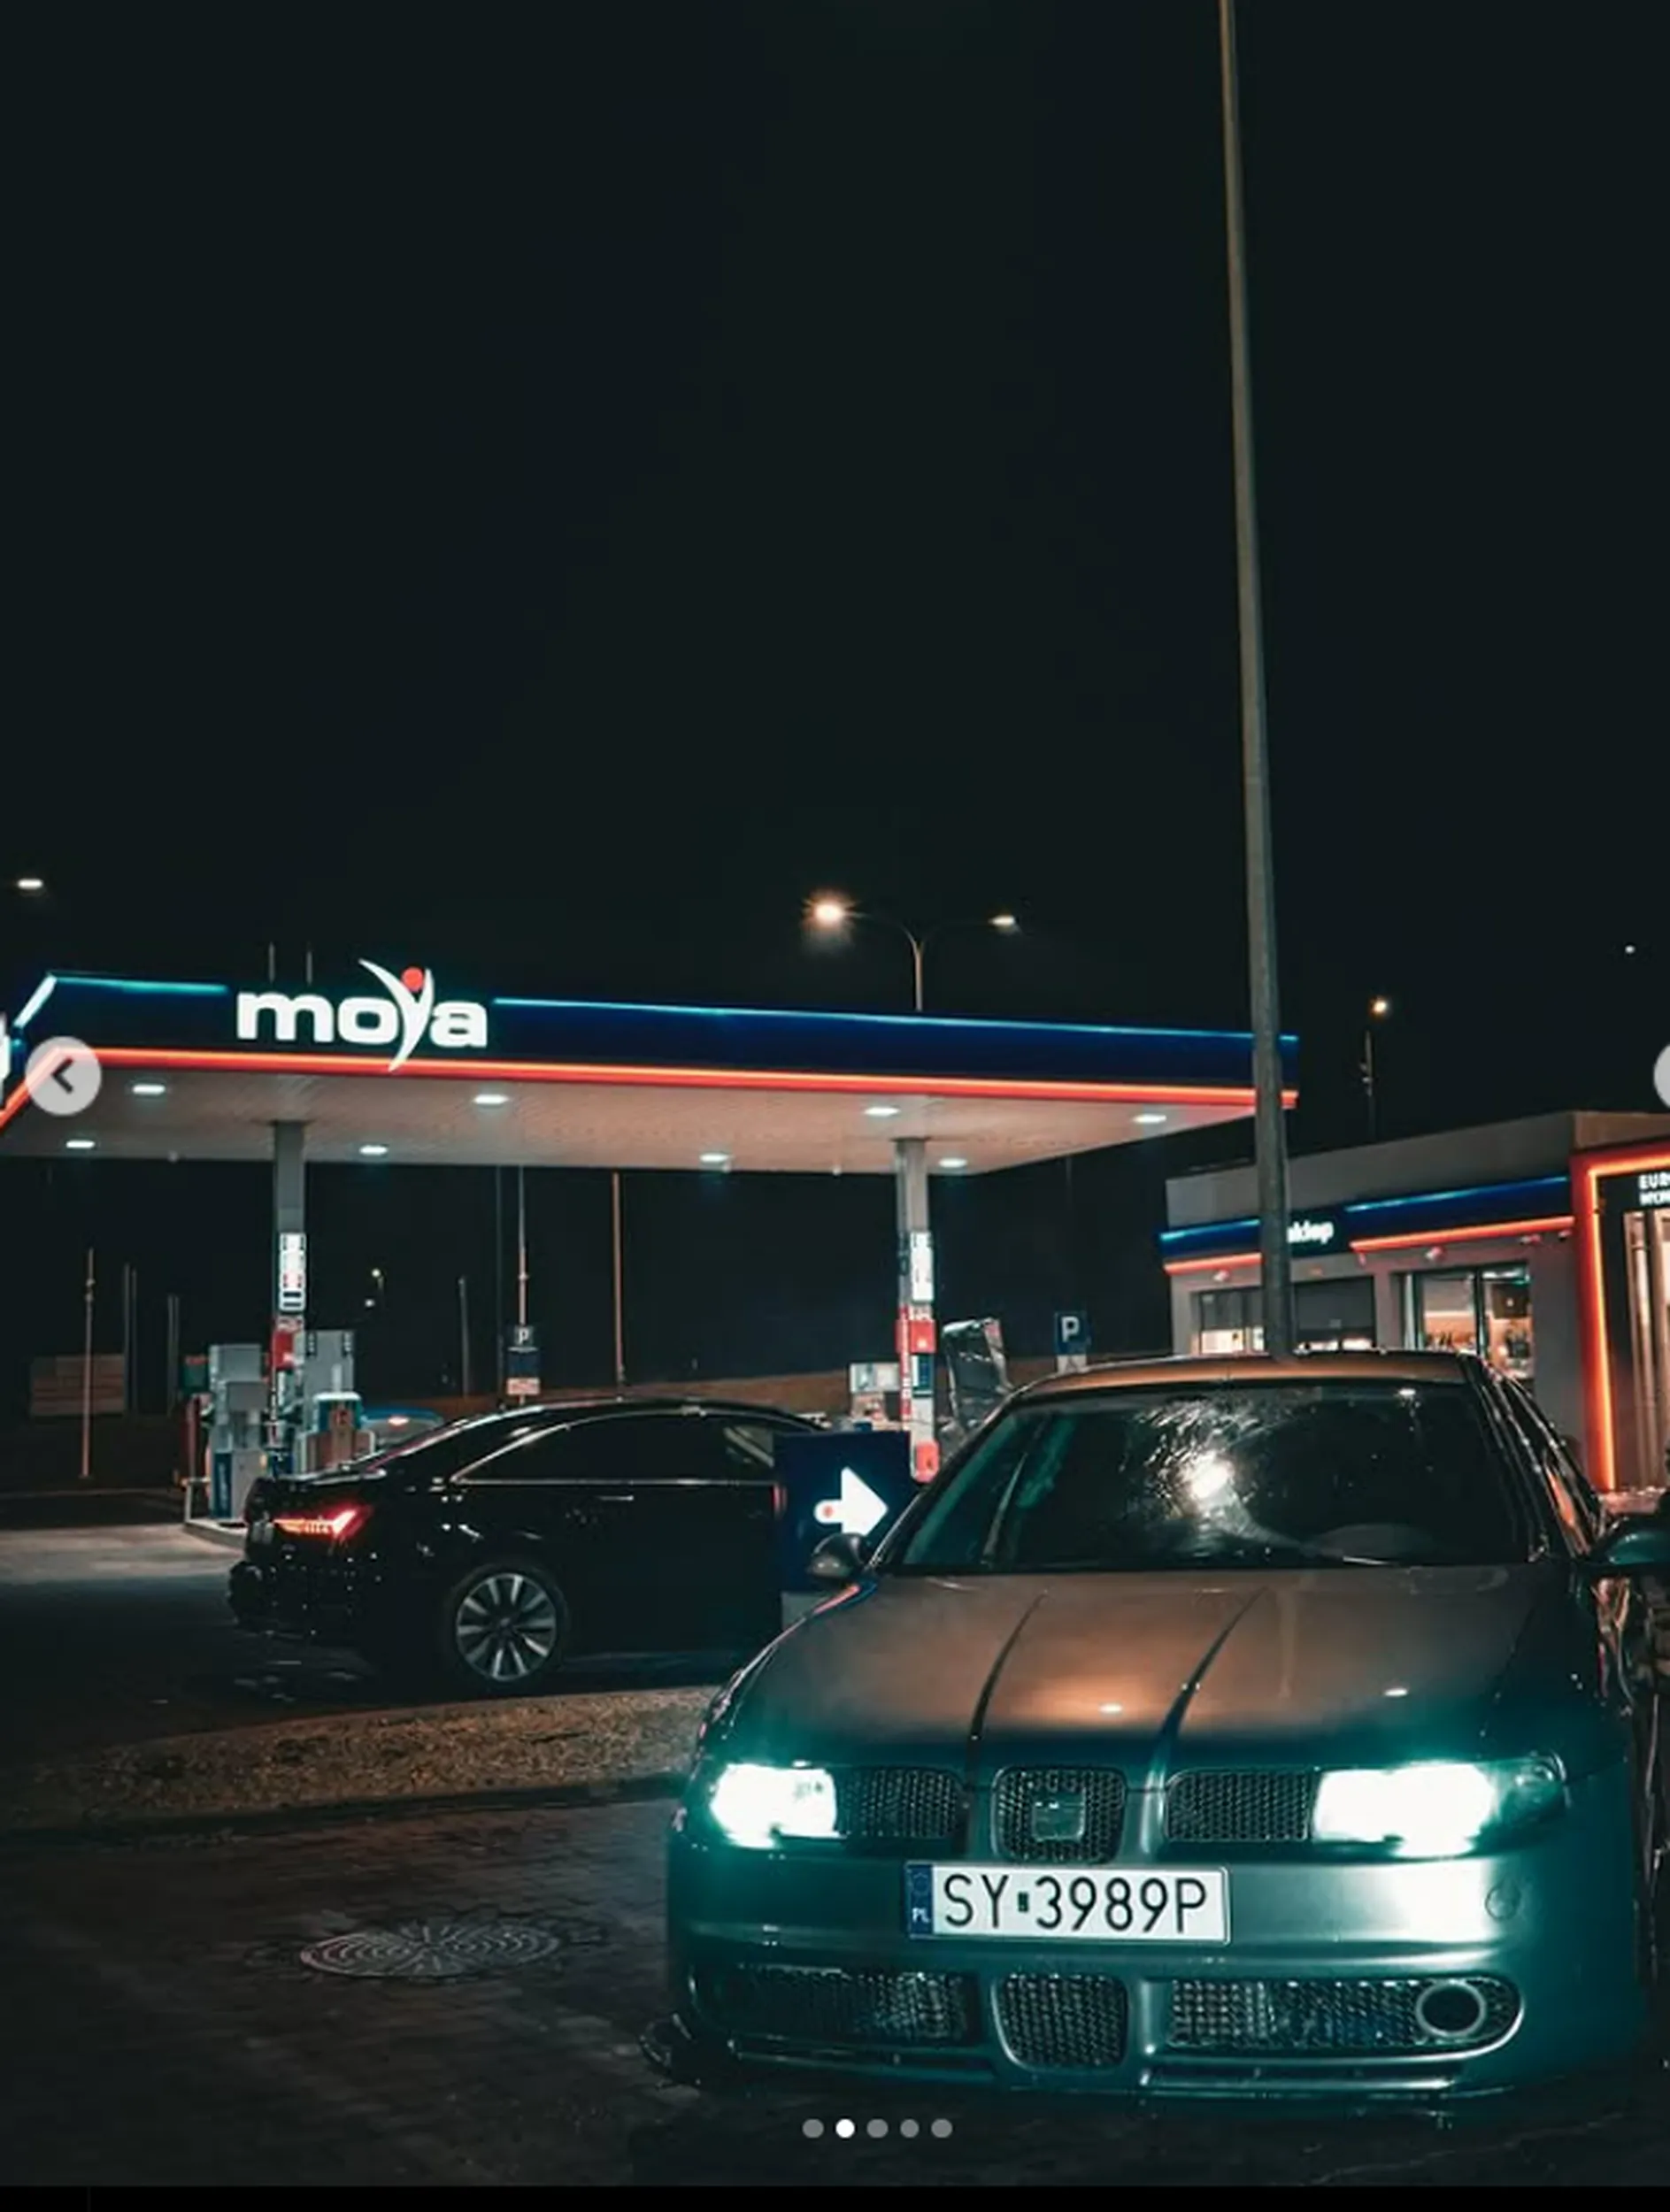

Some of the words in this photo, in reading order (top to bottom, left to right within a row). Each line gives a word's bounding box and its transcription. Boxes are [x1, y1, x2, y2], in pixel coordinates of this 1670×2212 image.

[236, 958, 487, 1071] moya
[1639, 1171, 1670, 1189] EUR
[1061, 1316, 1080, 1342] P
[912, 1907, 929, 1923] PL
[943, 1874, 1009, 1930] SY
[1035, 1876, 1207, 1933] 3989P
